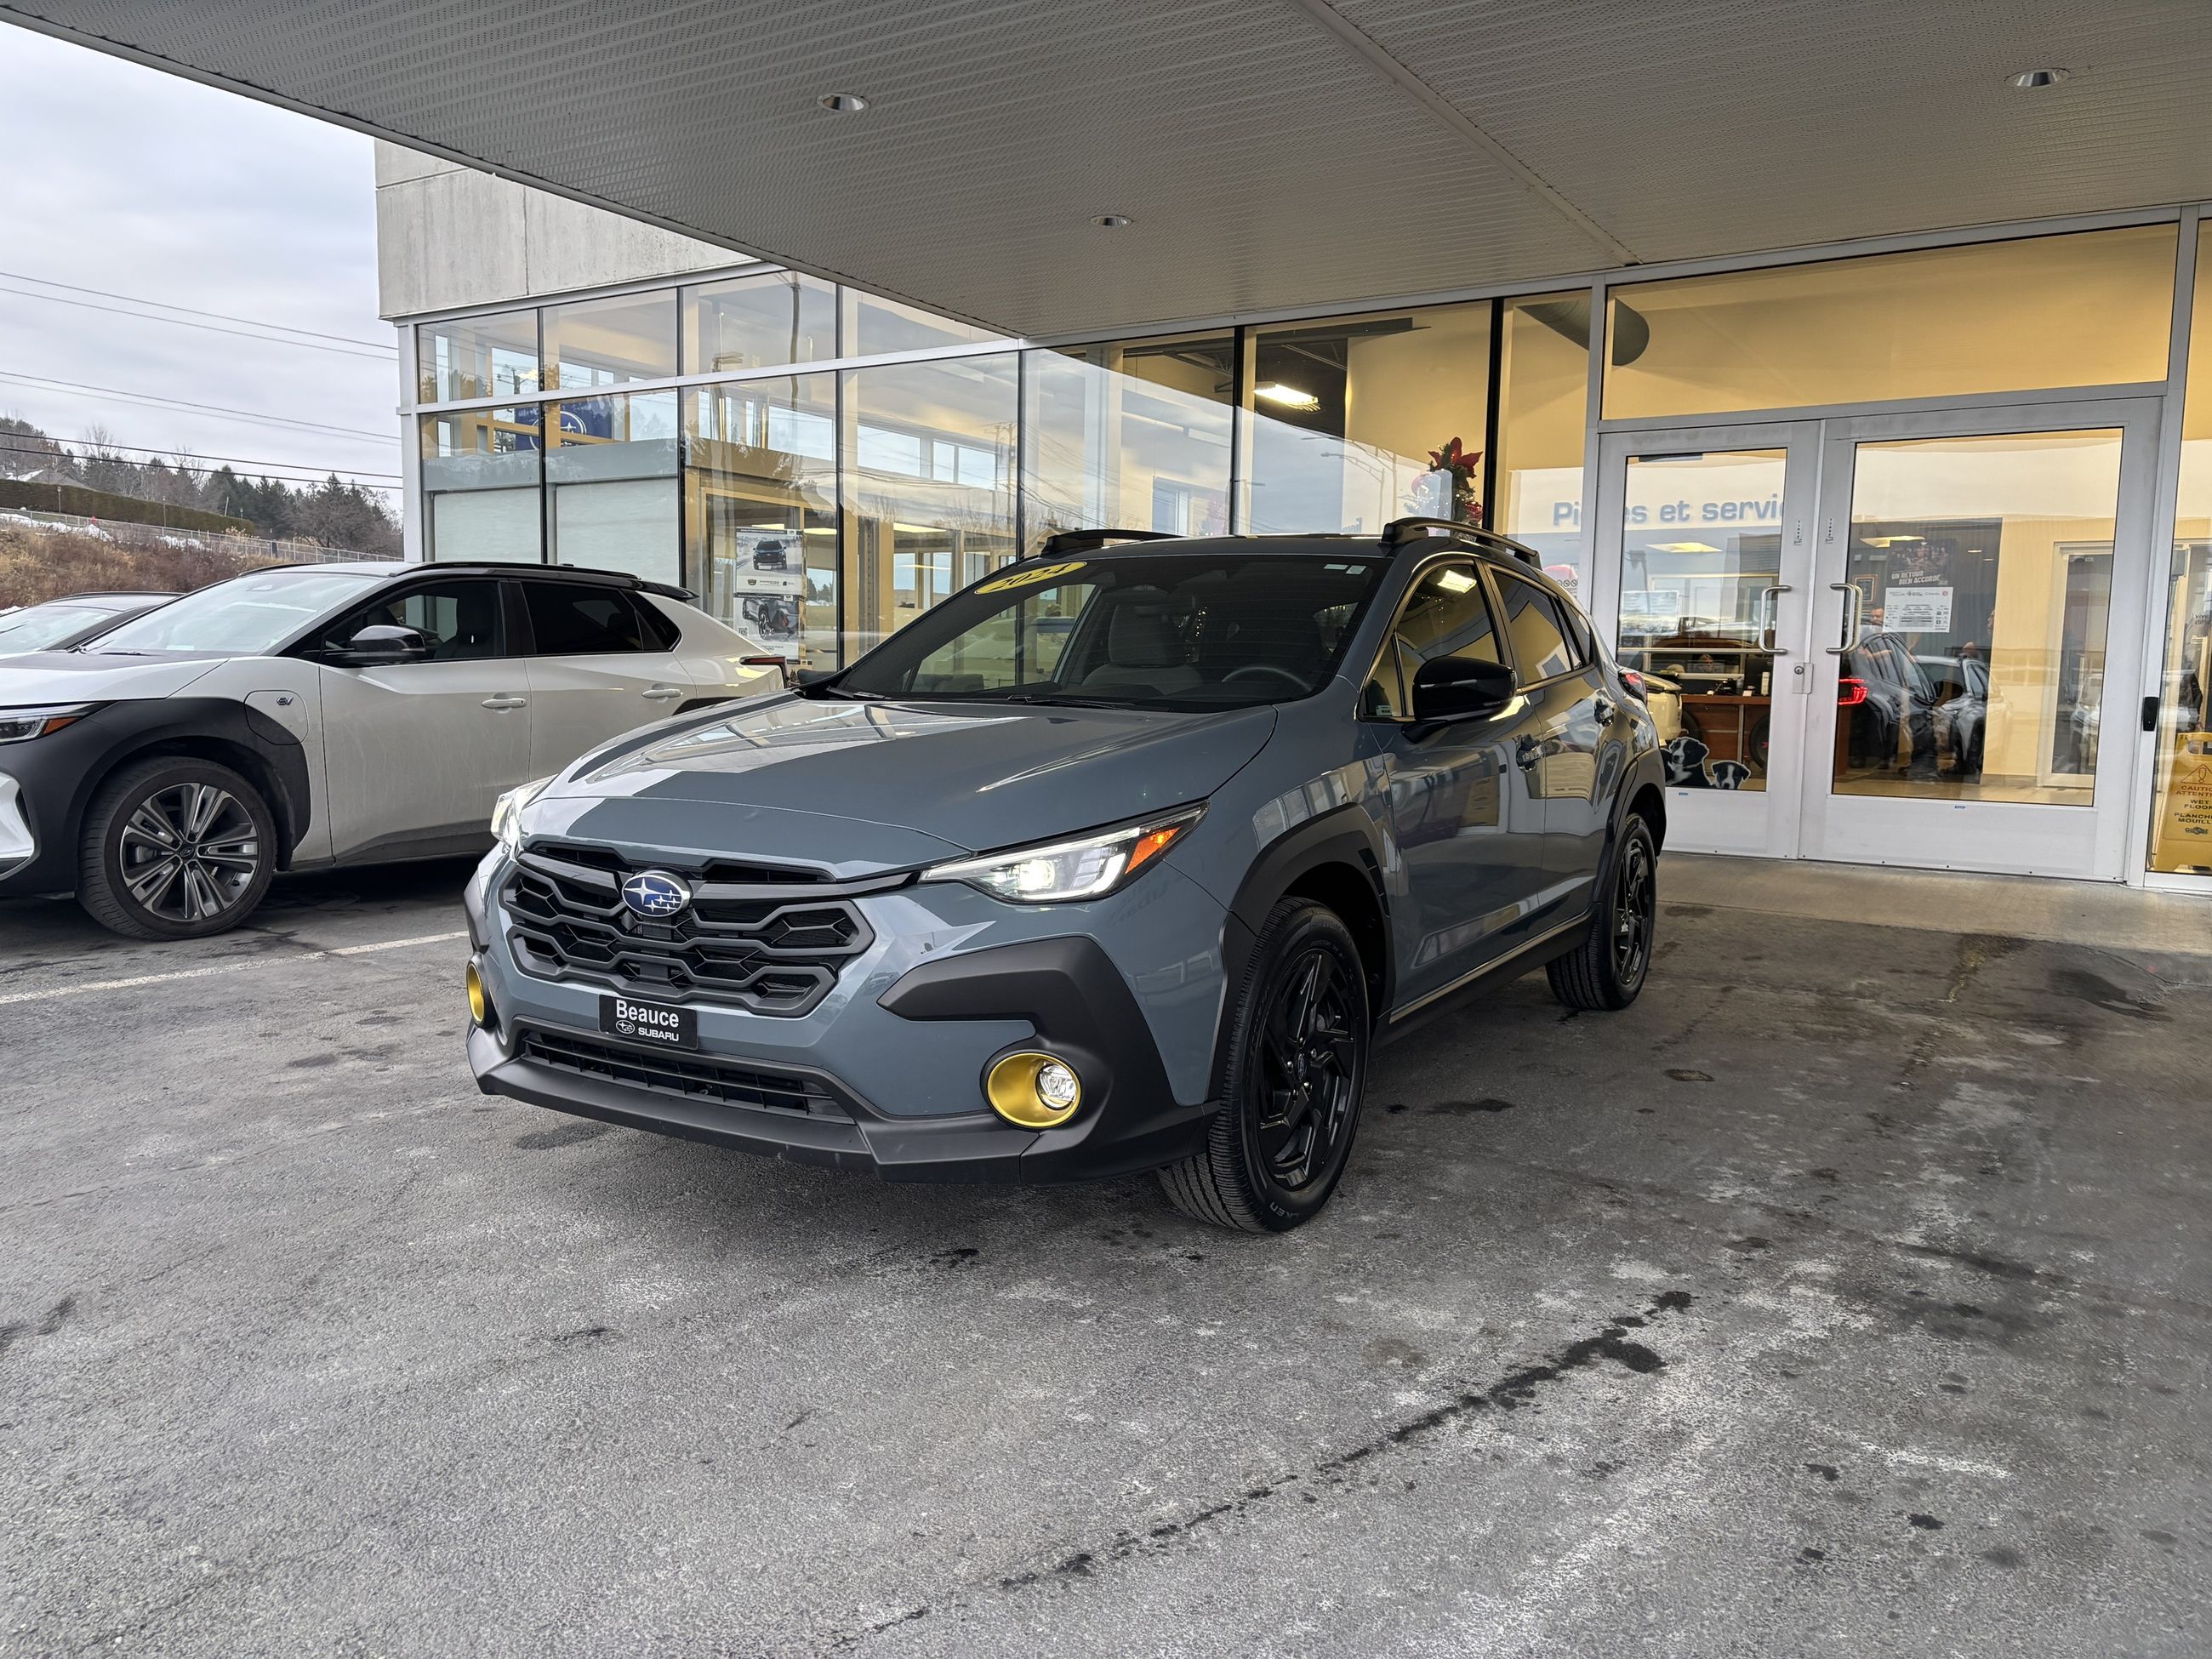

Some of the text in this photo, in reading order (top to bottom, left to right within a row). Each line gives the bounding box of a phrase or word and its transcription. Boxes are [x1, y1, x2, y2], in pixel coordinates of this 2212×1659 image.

[1660, 500, 1690, 522] et
[1702, 493, 1782, 521] servi
[985, 563, 1072, 593] 2024
[276, 697, 294, 705] EV
[616, 1000, 679, 1028] Beauce
[638, 1027, 679, 1041] SUBARU
